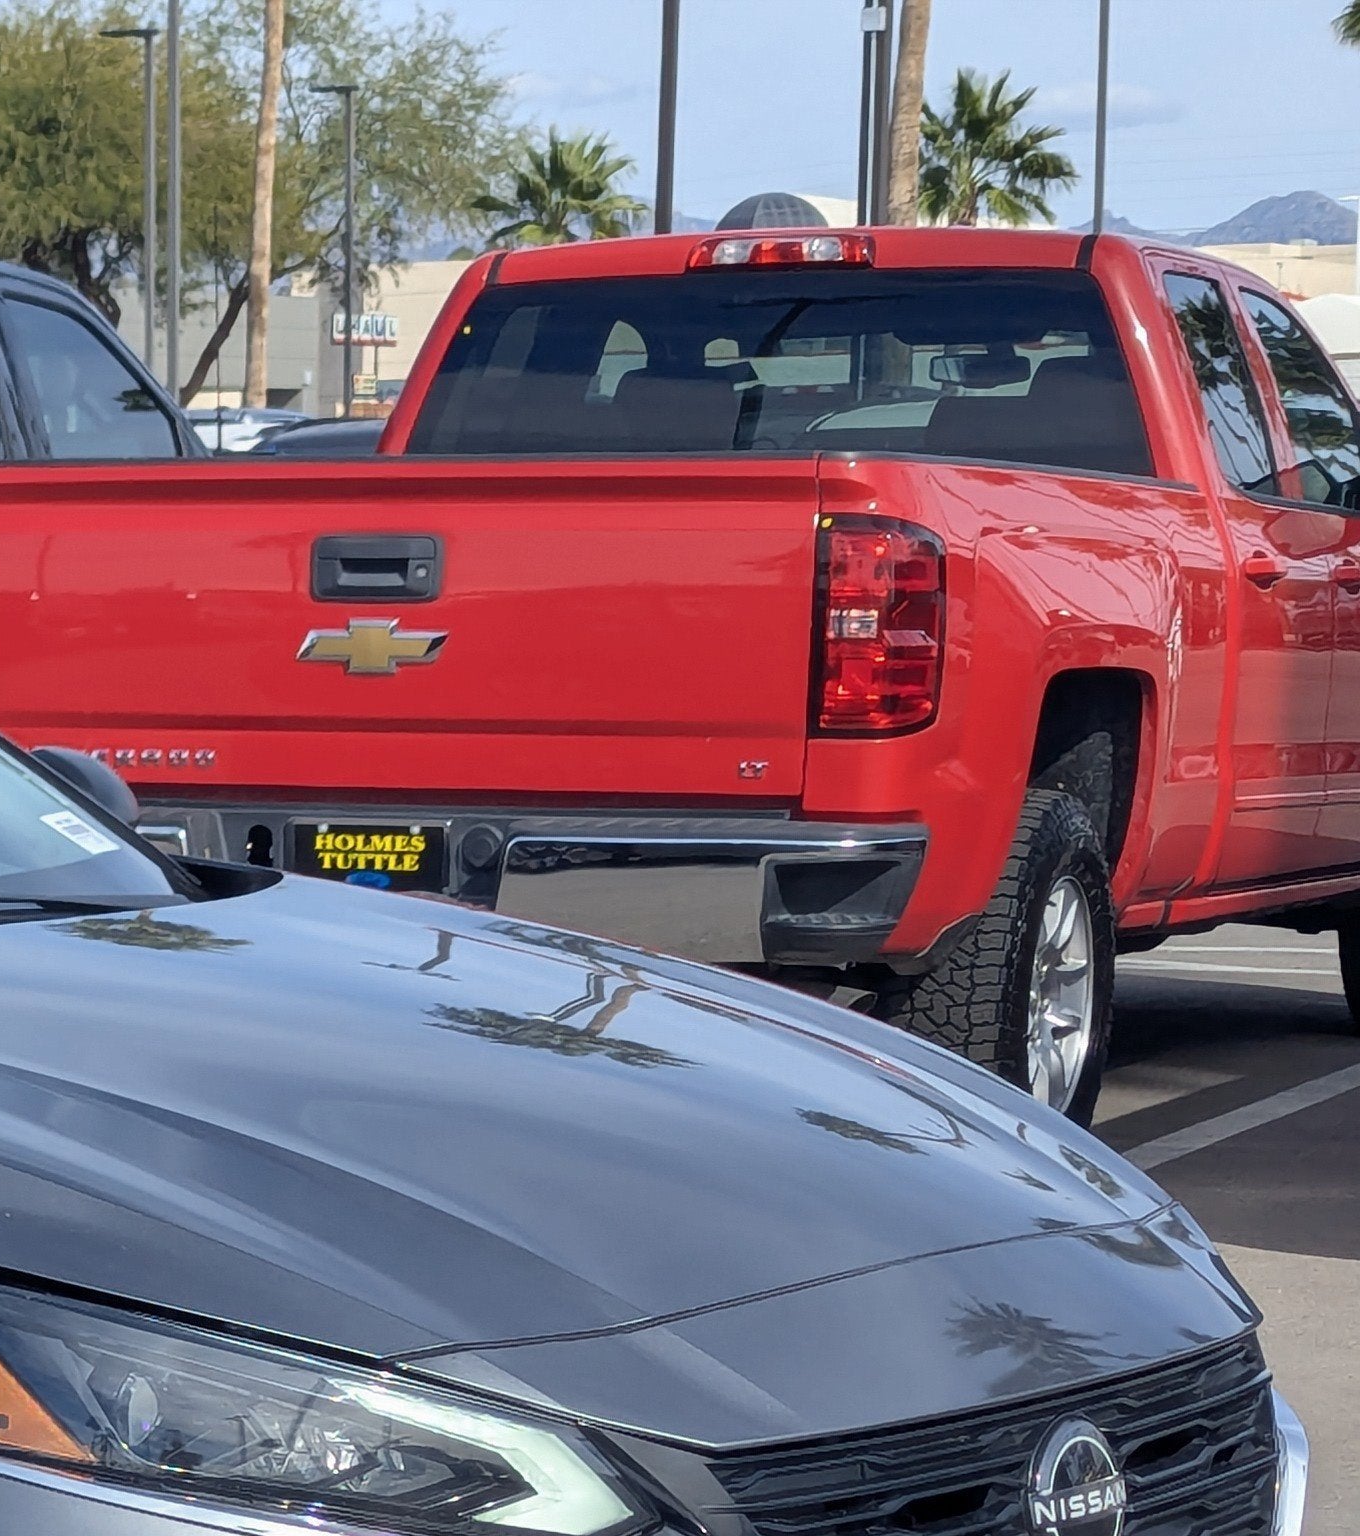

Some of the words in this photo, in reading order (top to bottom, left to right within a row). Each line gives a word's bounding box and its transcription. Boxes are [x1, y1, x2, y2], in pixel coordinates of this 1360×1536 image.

[314, 832, 426, 853] HOLMES
[317, 852, 421, 872] TUTTLE
[1033, 1479, 1127, 1526] NISSAN
